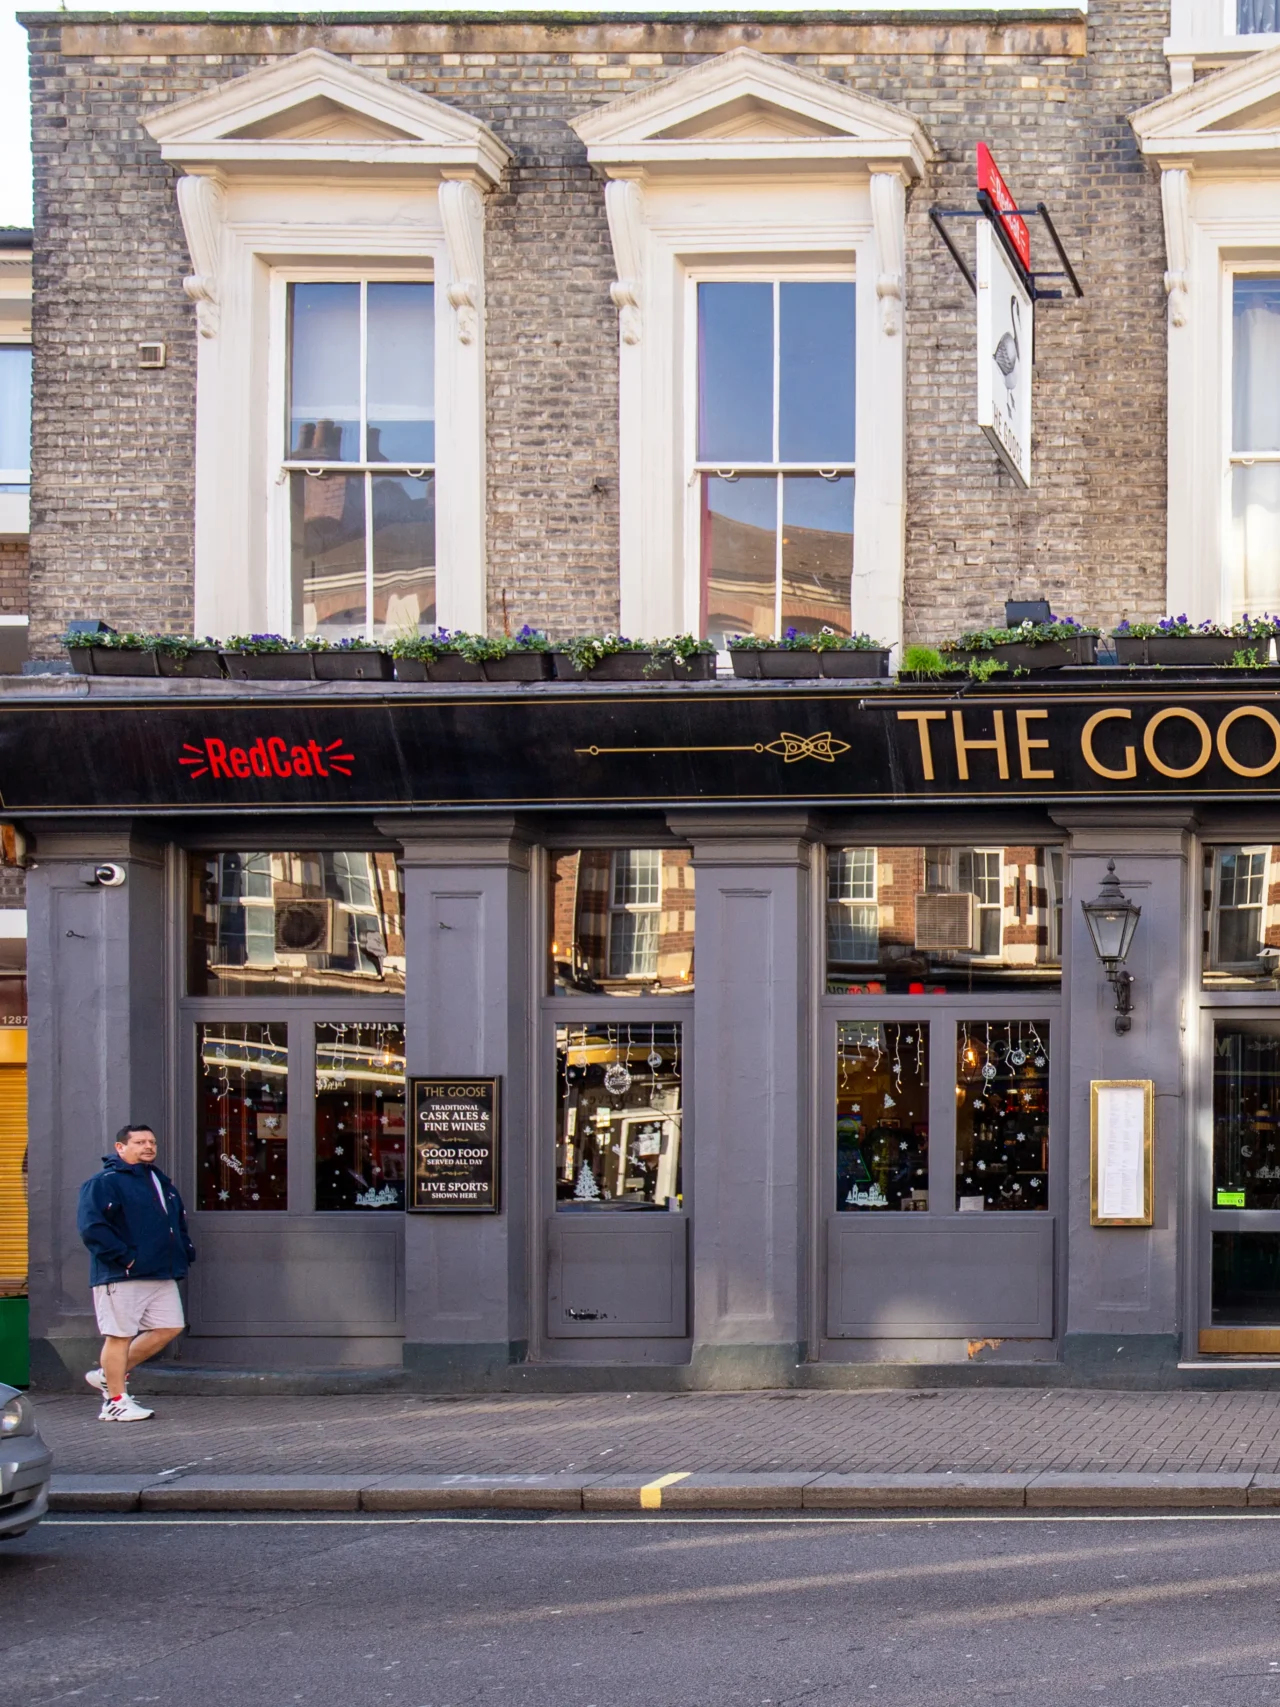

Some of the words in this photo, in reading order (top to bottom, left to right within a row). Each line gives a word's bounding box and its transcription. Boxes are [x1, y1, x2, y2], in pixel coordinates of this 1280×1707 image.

[897, 707, 1055, 781] THE
[204, 736, 329, 779] RedCat
[2, 1015, 28, 1025] 1287
[424, 1086, 445, 1097] THE
[447, 1086, 487, 1098] GOOSE
[420, 1111, 450, 1121] CASK
[452, 1111, 479, 1121] ALES
[480, 1111, 490, 1121] &
[424, 1122, 449, 1131] FINE
[451, 1122, 486, 1132] WINES
[421, 1148, 456, 1158] GOOD
[458, 1148, 489, 1158] FOOD
[427, 1158, 454, 1166] SERVED
[455, 1158, 468, 1166] ALL
[469, 1158, 483, 1166] DAY
[421, 1182, 446, 1192] LIVE
[448, 1182, 488, 1192] SPORTS
